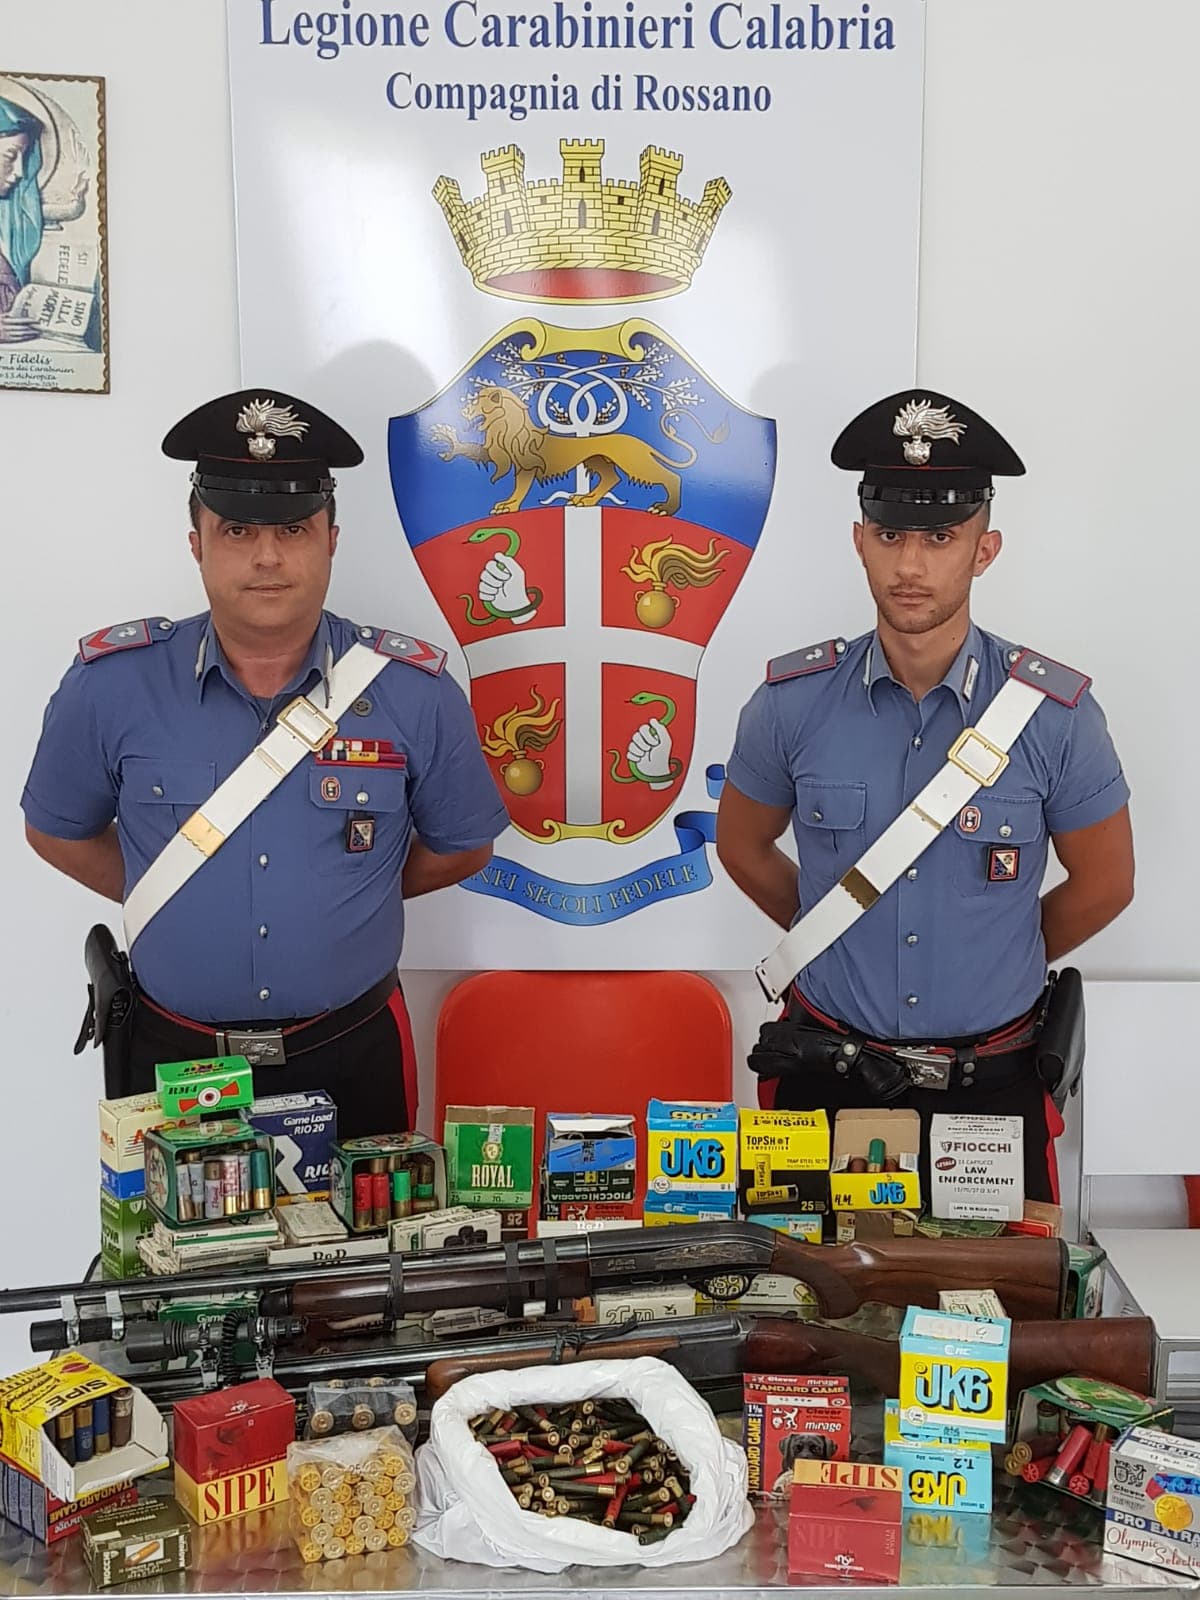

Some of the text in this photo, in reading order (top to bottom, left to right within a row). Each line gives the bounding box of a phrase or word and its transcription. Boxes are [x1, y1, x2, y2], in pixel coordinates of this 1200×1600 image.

[258, 0, 897, 58] Legione Carabinieri Calabria
[385, 72, 772, 120] Compagnia di Rossano
[57, 244, 71, 285] FEDELE
[39, 288, 60, 327] MORTE
[55, 295, 72, 325] ALLA
[71, 301, 87, 327] SINO
[10, 354, 51, 364] Fidelis
[522, 880, 604, 914] SECOLI
[609, 864, 699, 910] FEDELE
[284, 1111, 334, 1126] Game Load
[294, 1123, 325, 1135] RIO 20
[660, 1138, 724, 1178] JK6
[954, 1142, 1012, 1153] FIOCCHI
[472, 1164, 514, 1188] ROYAL
[938, 1176, 1015, 1186] ENFORCEMENT
[588, 1192, 632, 1200] FIOCCHI
[801, 1200, 814, 1212] 25
[870, 1182, 906, 1204] JK6
[46, 1379, 108, 1407] SIPE
[749, 1383, 808, 1392] STANDARD
[915, 1364, 992, 1414] JK6
[748, 1418, 762, 1445] GAME
[805, 1421, 842, 1432] mirage
[820, 1462, 899, 1490] SIPE
[954, 1458, 975, 1470] T.2
[203, 1466, 276, 1523] SIPE
[908, 1470, 968, 1506] JK6
[1114, 1484, 1146, 1498] Clever
[49, 1479, 134, 1524] STANDARD GAME
[1114, 1512, 1146, 1529] PRO
[794, 1522, 847, 1548] SIPE
[1106, 1526, 1158, 1551] Olympic
[102, 1552, 112, 1585] FIOCCHI
